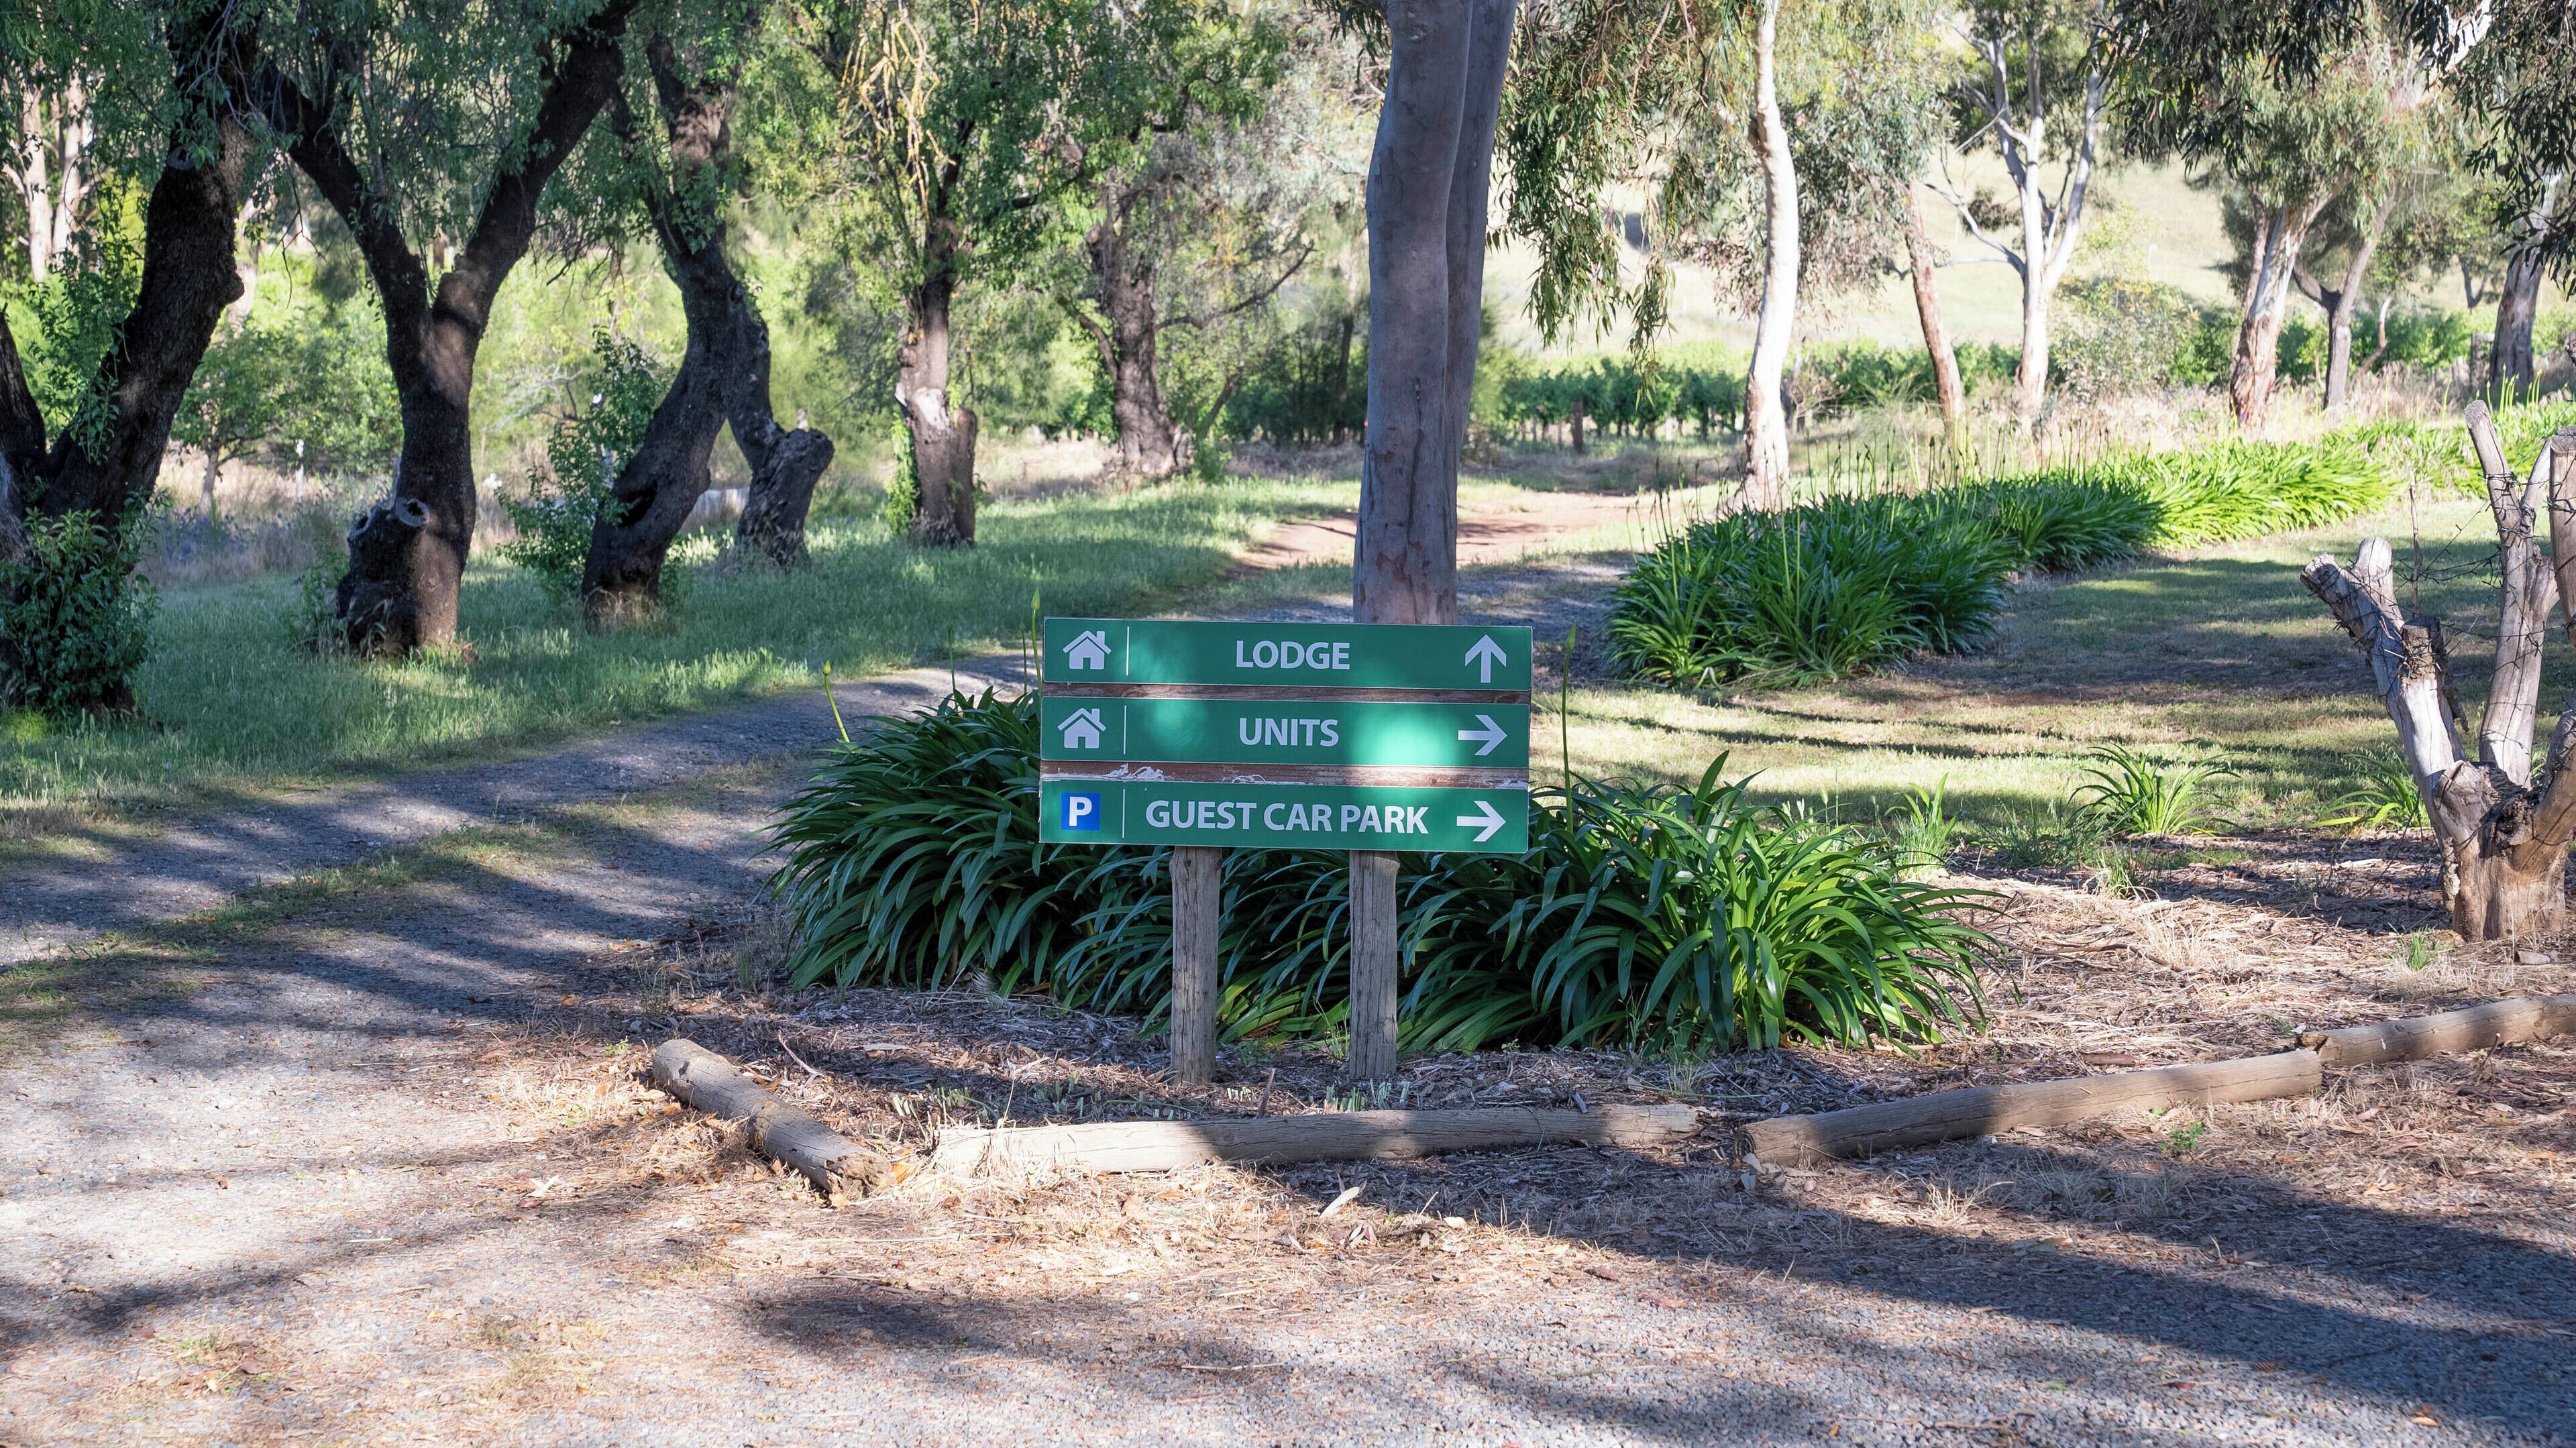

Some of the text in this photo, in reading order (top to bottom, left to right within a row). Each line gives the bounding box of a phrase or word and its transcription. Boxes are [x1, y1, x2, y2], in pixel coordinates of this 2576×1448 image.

[1236, 641, 1350, 670] LODGE
[1240, 718, 1339, 746] UNITS
[1069, 796, 1092, 827] P
[1146, 800, 1429, 834] GUEST CAR PARK
